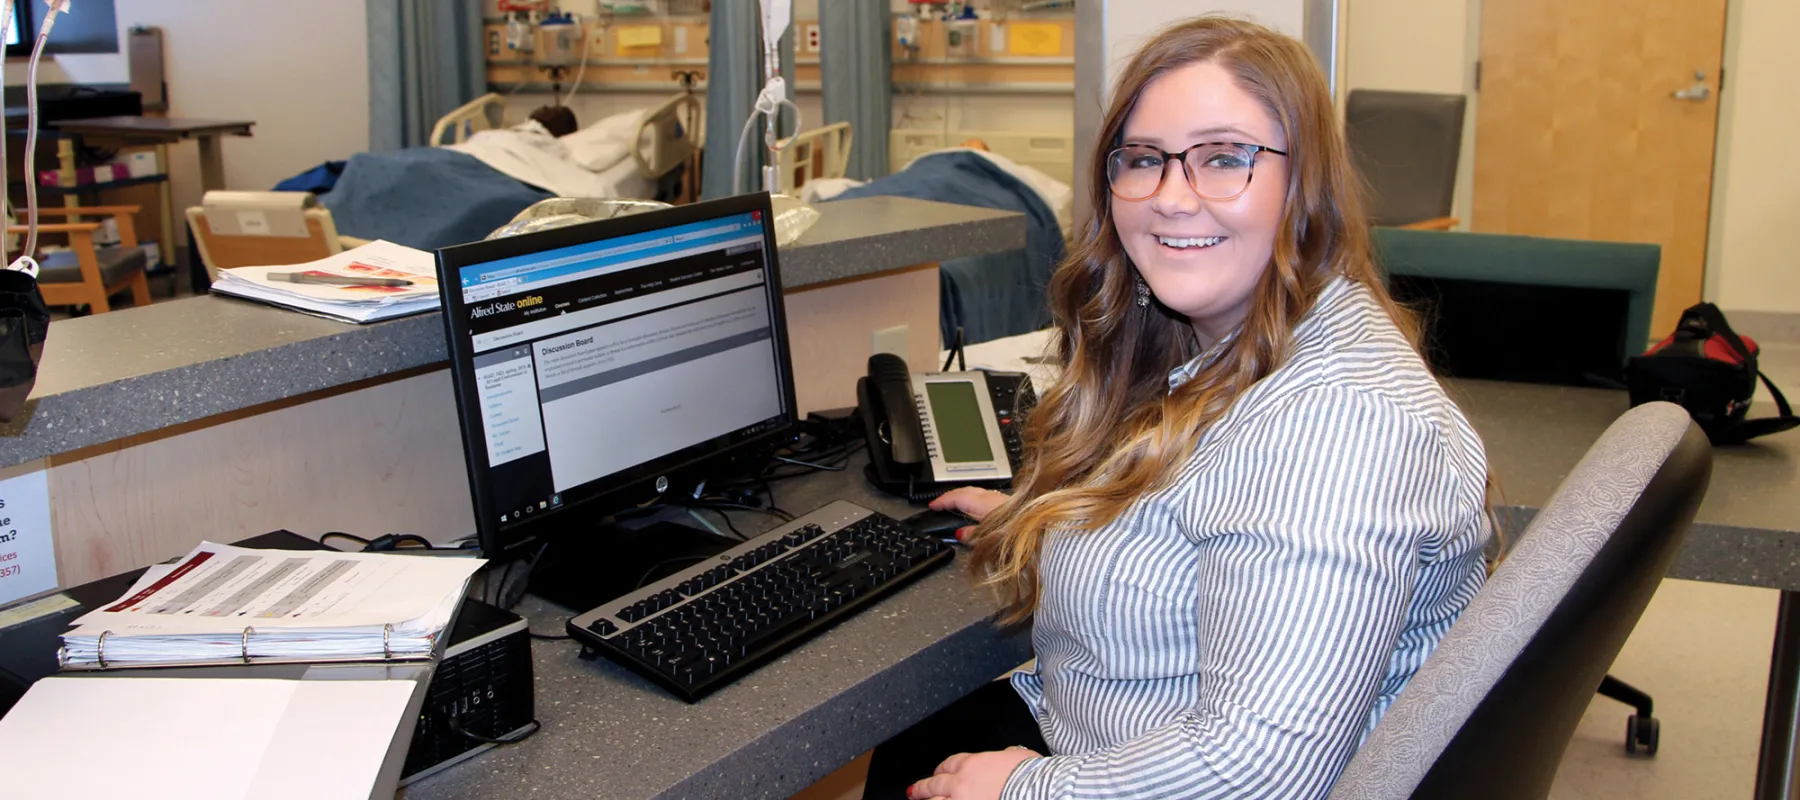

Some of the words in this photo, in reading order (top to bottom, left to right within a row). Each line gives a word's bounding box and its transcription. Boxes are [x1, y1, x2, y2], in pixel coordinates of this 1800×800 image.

[470, 304, 494, 319] Alfred
[495, 301, 516, 314] State
[516, 296, 543, 308] online
[554, 301, 571, 310] Courses
[541, 340, 575, 356] Discussion
[575, 336, 594, 348] Board
